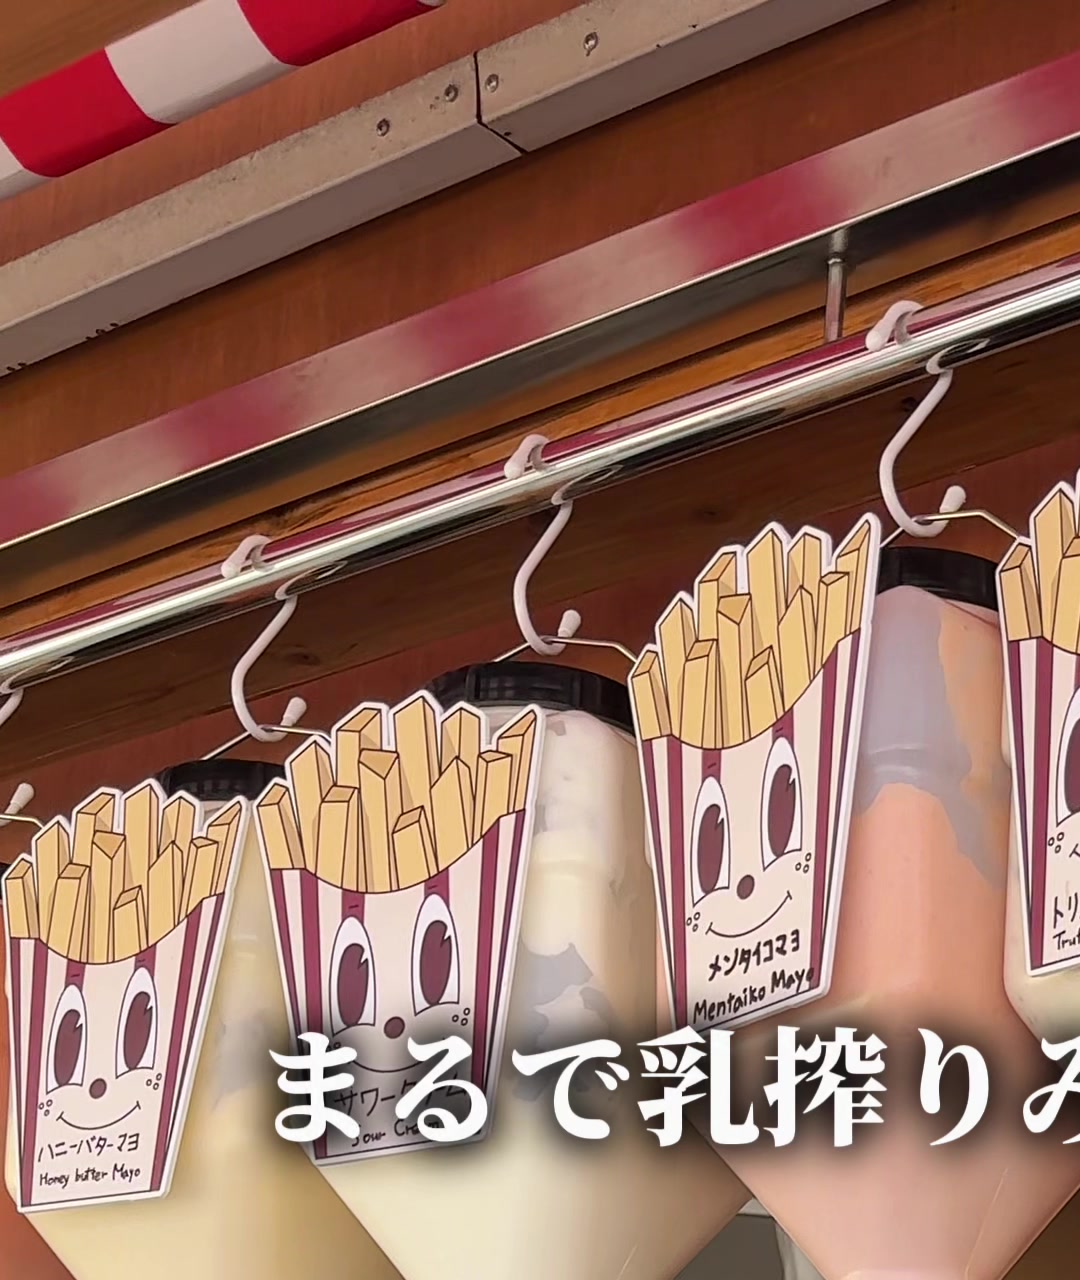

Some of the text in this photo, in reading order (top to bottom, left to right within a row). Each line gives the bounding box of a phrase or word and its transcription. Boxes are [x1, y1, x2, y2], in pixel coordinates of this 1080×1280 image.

[708, 928, 800, 981] メンタイコマヨ
[693, 967, 814, 1024] Mentaiko Mayo
[38, 1133, 139, 1162] ハニーバターマヨ
[40, 1172, 69, 1189] Honey
[112, 1163, 140, 1182] Mayo
